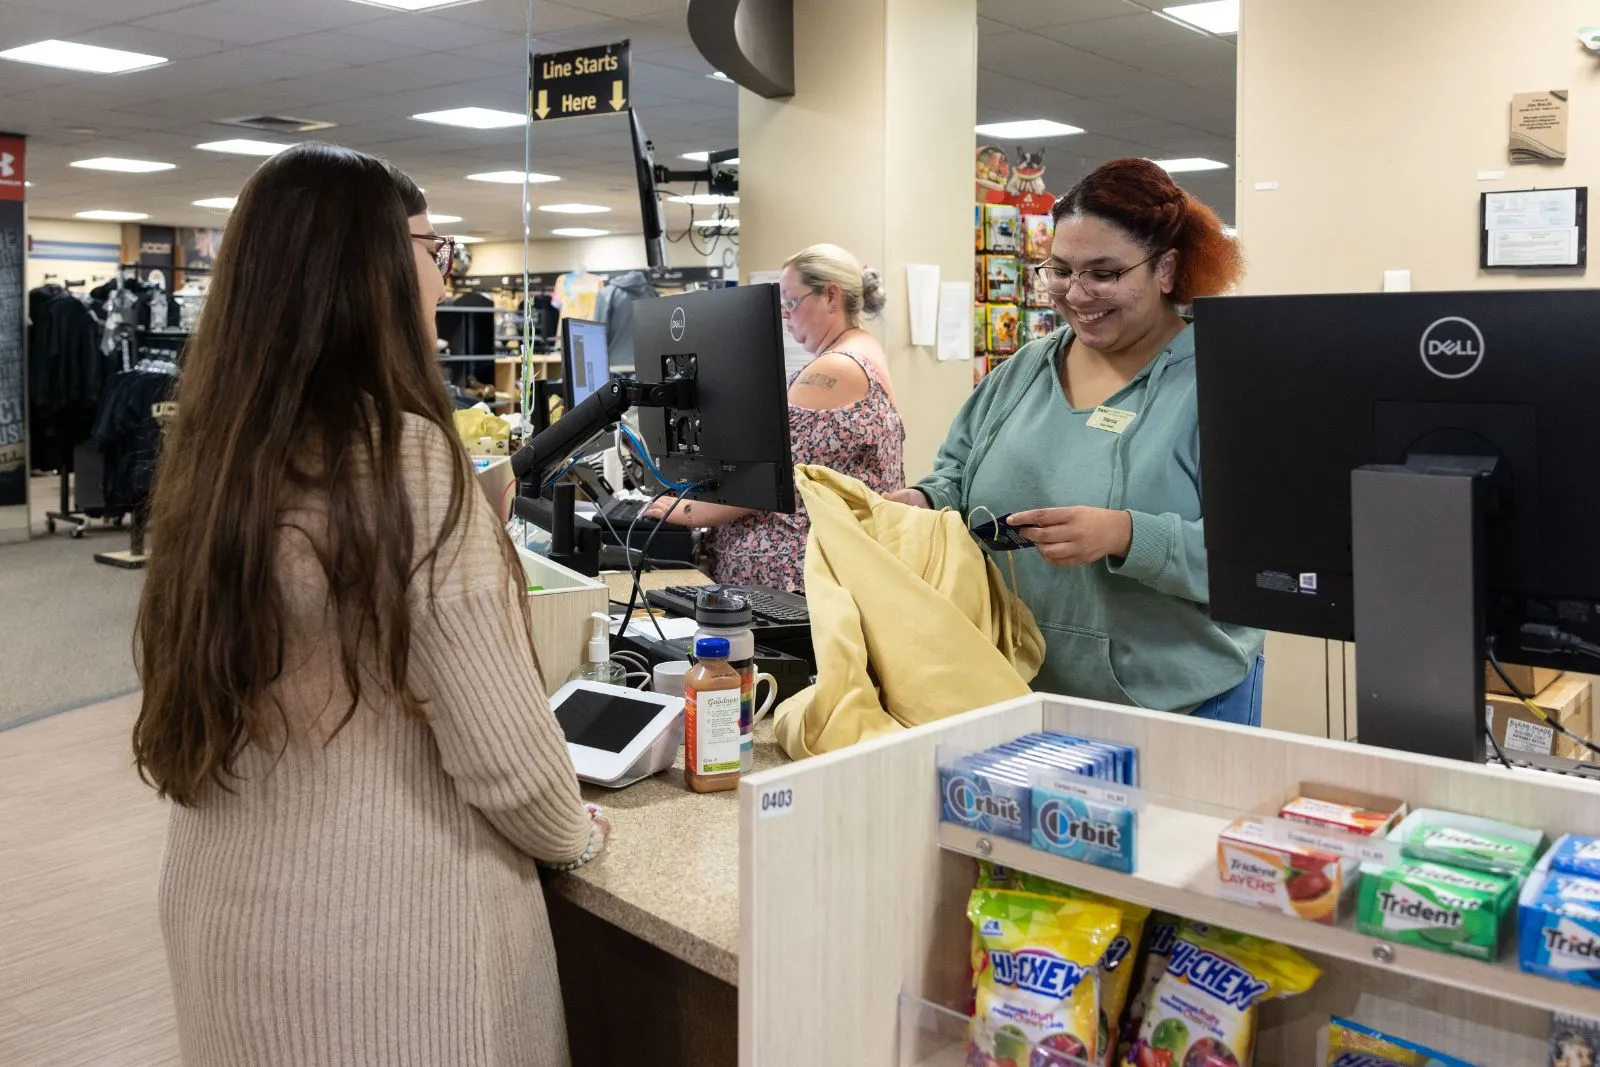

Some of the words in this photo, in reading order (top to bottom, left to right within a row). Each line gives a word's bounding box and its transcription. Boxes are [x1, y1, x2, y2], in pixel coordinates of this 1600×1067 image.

[543, 61, 572, 80] Line
[574, 54, 619, 75] Starts
[561, 94, 597, 113] Here
[1428, 339, 1477, 355] DELL
[761, 788, 793, 811] 0403
[946, 774, 1022, 825] Orbit
[1037, 798, 1122, 852] Orbit
[1230, 857, 1277, 878] Trident
[1219, 872, 1276, 894] LAYERS
[1379, 891, 1461, 927] Trident
